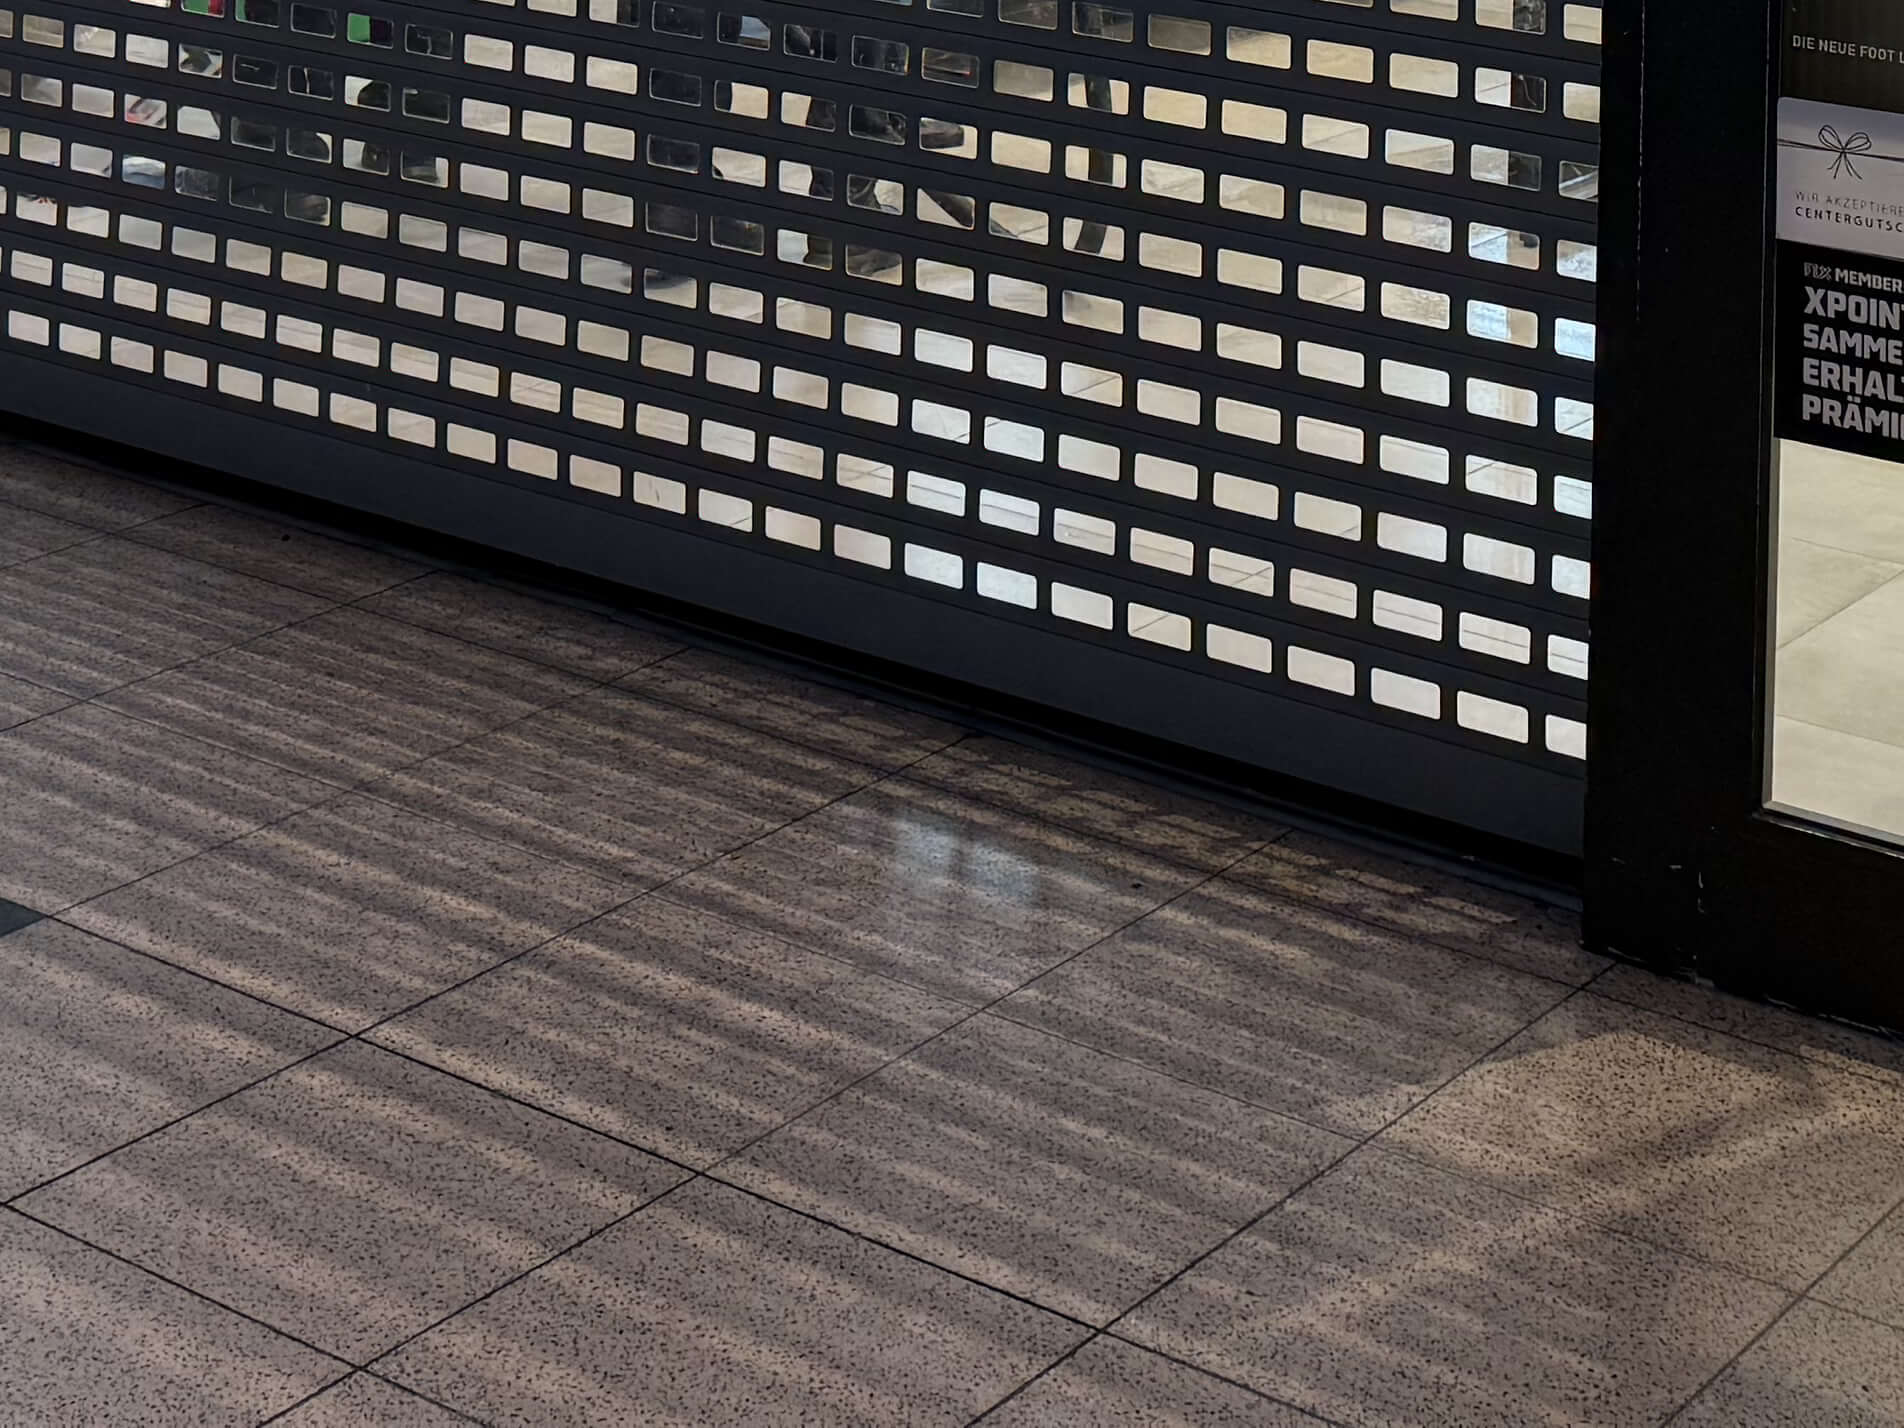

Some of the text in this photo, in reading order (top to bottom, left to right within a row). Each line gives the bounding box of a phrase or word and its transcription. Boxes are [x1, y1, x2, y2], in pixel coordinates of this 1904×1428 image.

[1792, 35, 1816, 50] DIE
[1818, 39, 1857, 57] NEUE
[1859, 45, 1896, 62] FOOT
[1795, 191, 1819, 204] WIR
